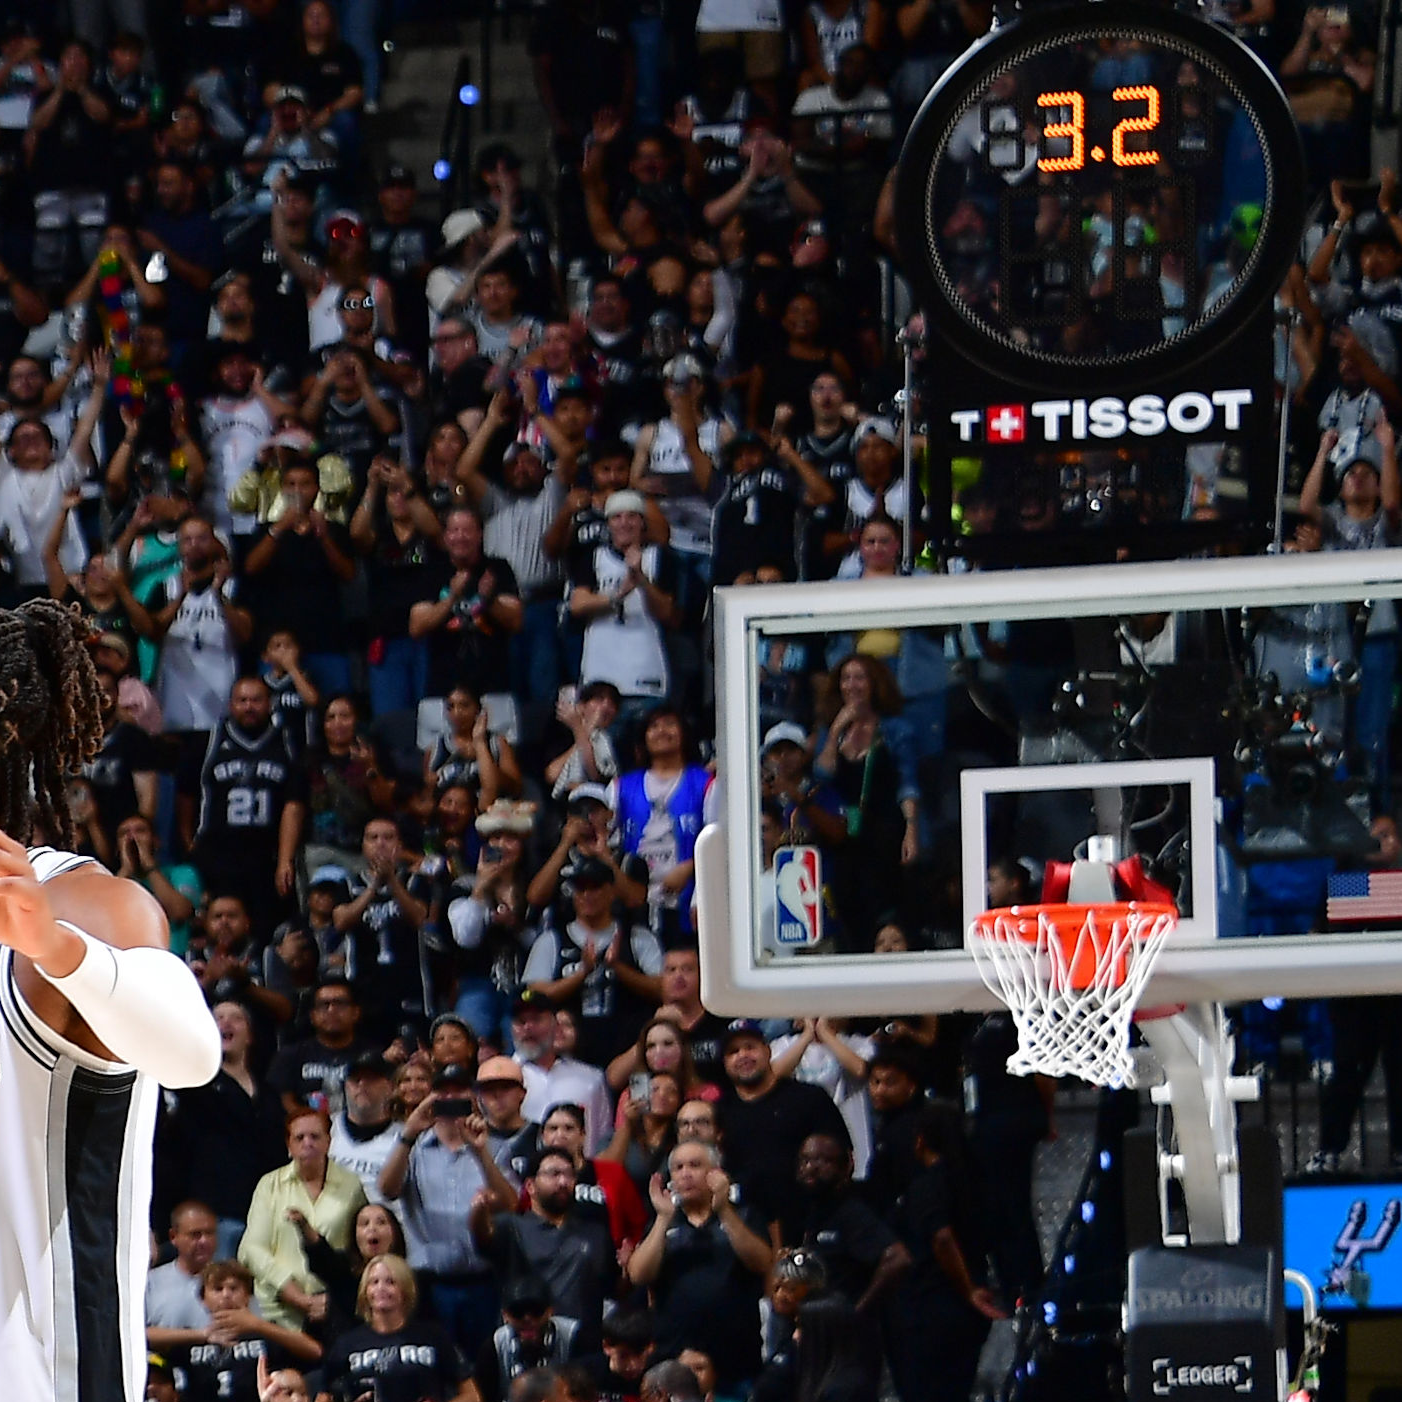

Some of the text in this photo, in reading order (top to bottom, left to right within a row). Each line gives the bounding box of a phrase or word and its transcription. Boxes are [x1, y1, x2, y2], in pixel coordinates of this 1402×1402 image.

[1037, 85, 1160, 172] 3.2
[1032, 388, 1254, 441] TISSOT
[1137, 1286, 1266, 1312] SPALDING
[1166, 1364, 1239, 1388] LEDGER
